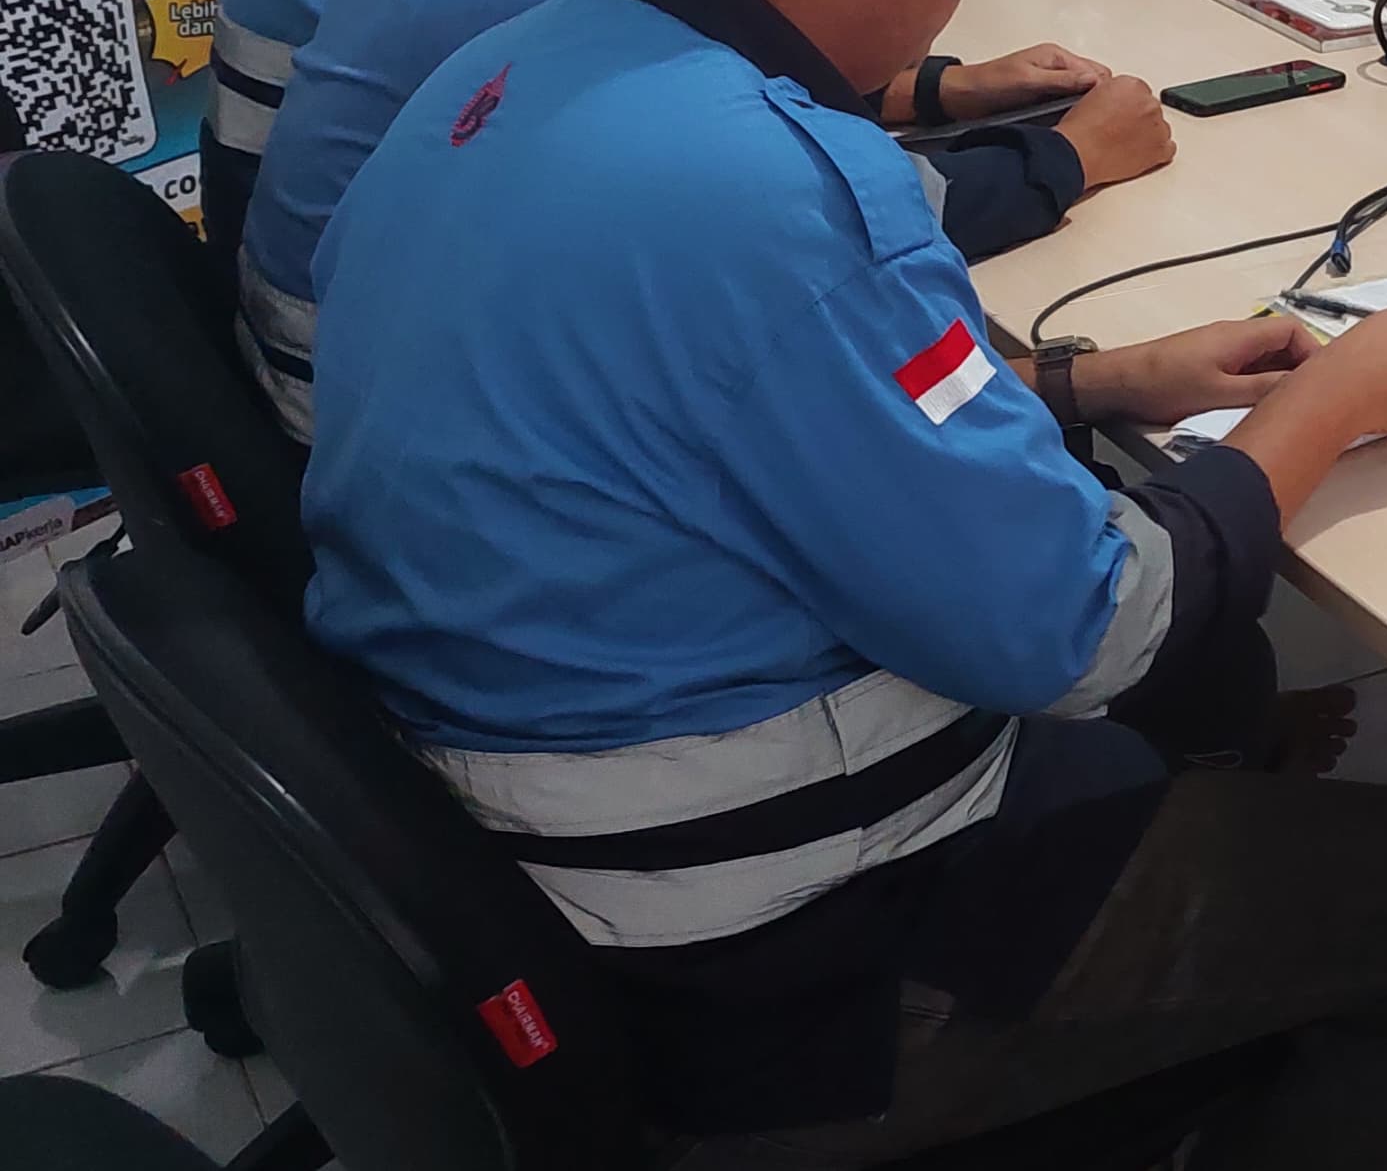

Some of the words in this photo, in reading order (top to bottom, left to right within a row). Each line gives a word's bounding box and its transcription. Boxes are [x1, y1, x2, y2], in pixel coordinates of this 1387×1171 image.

[179, 22, 214, 37] dan
[195, 470, 225, 517] CHAIRMAN
[507, 990, 546, 1048] CHAIRMAN
